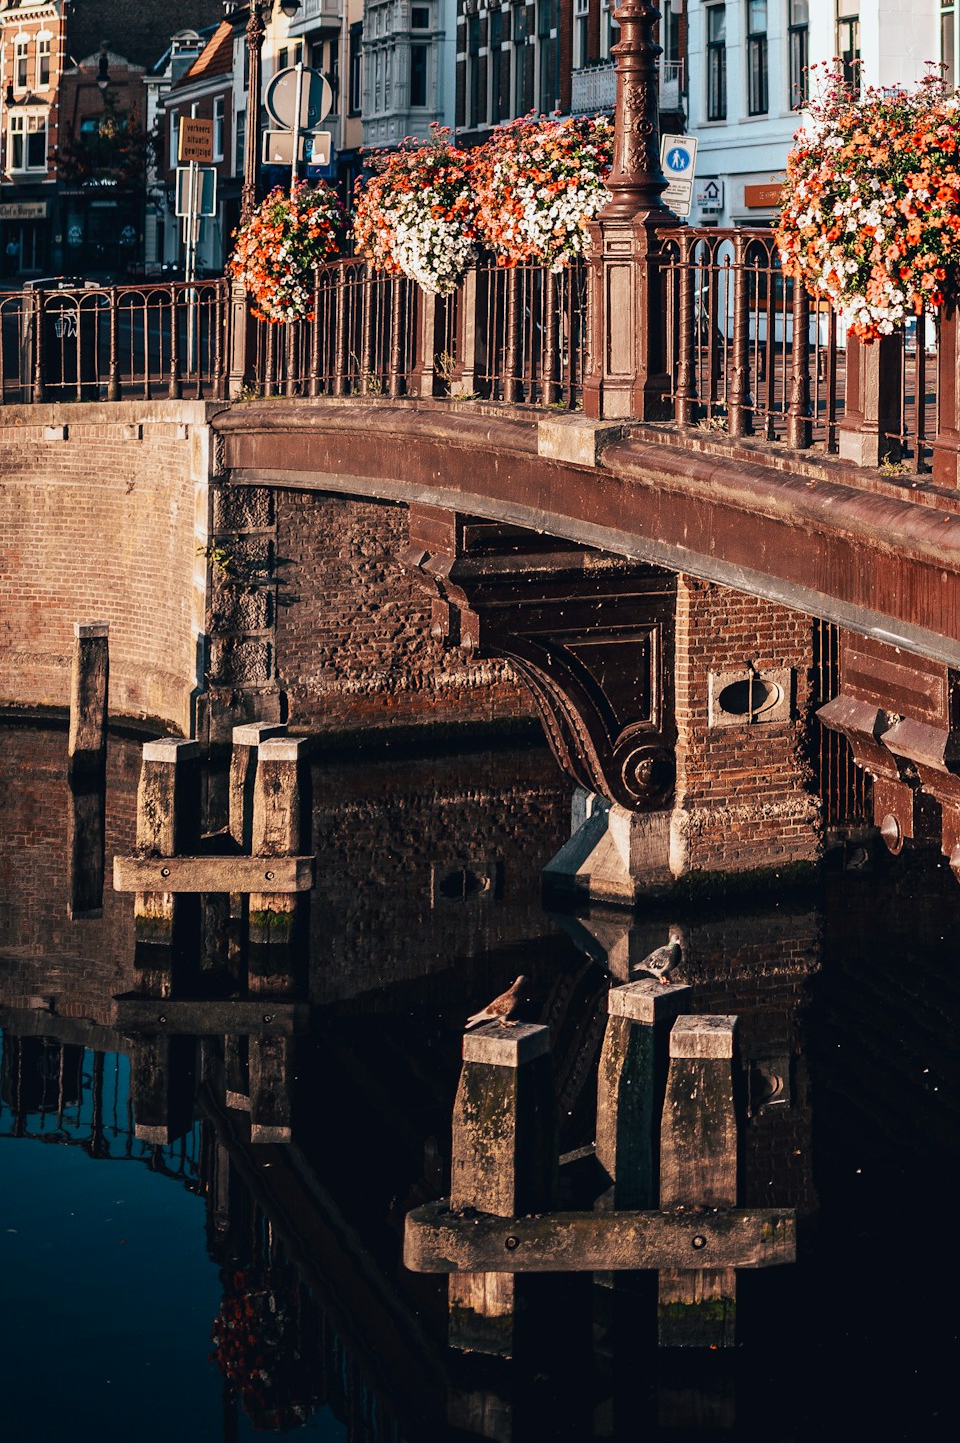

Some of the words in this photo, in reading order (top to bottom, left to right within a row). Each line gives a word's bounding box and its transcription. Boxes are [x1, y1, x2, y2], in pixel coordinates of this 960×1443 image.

[187, 125, 210, 134] verkeers
[187, 136, 209, 145] situatie
[184, 147, 211, 158] gewijzigd
